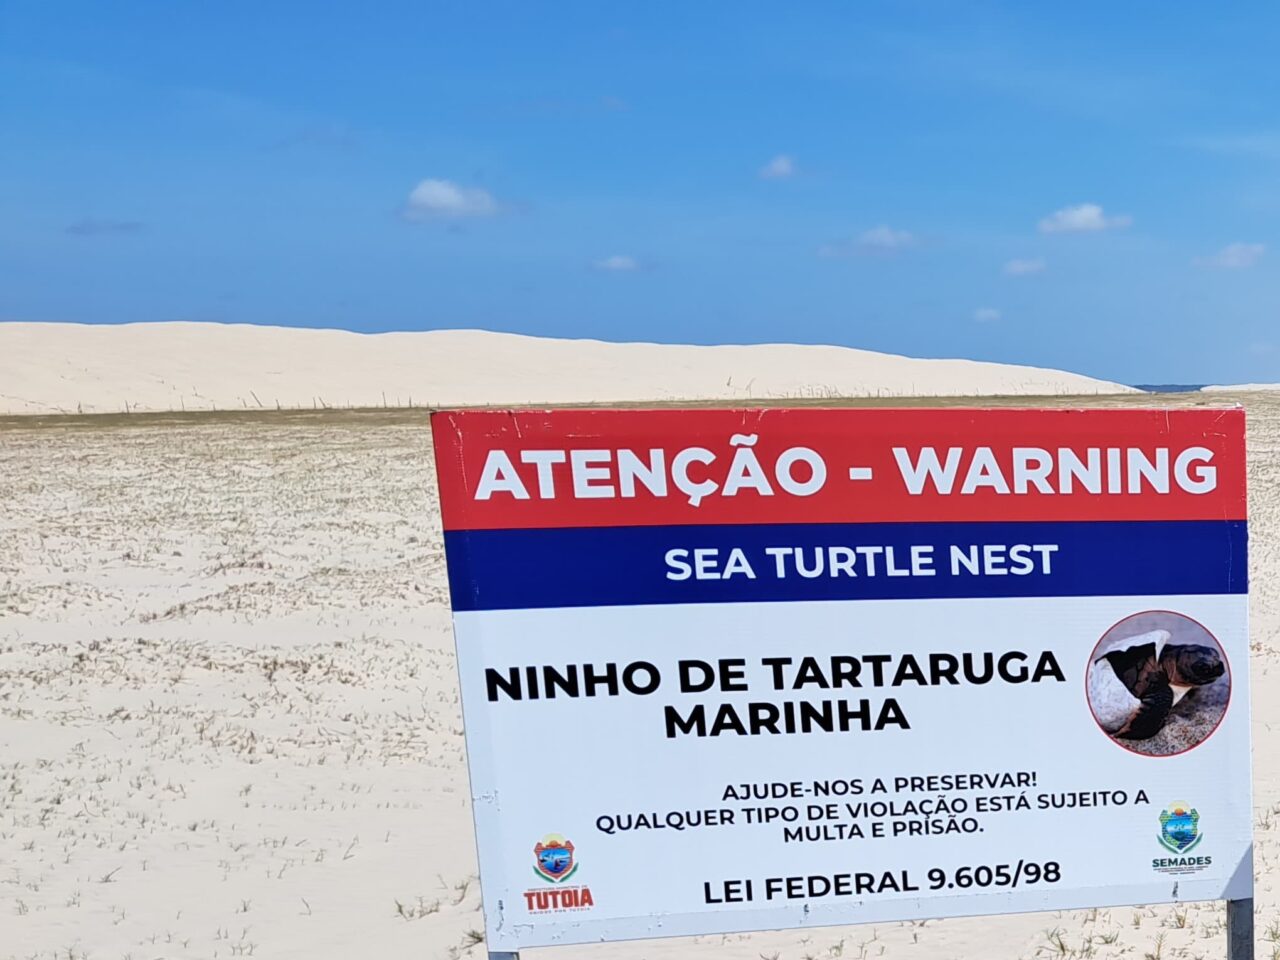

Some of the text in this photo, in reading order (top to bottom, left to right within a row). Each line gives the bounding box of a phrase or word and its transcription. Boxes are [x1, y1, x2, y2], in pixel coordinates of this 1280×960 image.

[474, 433, 827, 507] ATENÇÃO
[892, 446, 1218, 495] WARNING
[664, 543, 1059, 581] SEA TURTLE NEST
[485, 650, 1066, 702] NINHO DE TARTARUGA
[664, 698, 911, 738] MARINHA
[722, 771, 1037, 801] AJUDE-NOS A PRESERVAR!
[596, 789, 1150, 834] QUALQUER TIPO DE VIOLAÇÃO ESTÁ SUJEITO A
[783, 814, 984, 843] MULTA E PRISÃO.
[704, 859, 1061, 904] LEI FEDERAL 9.605/98
[1152, 856, 1212, 868] SEMADES
